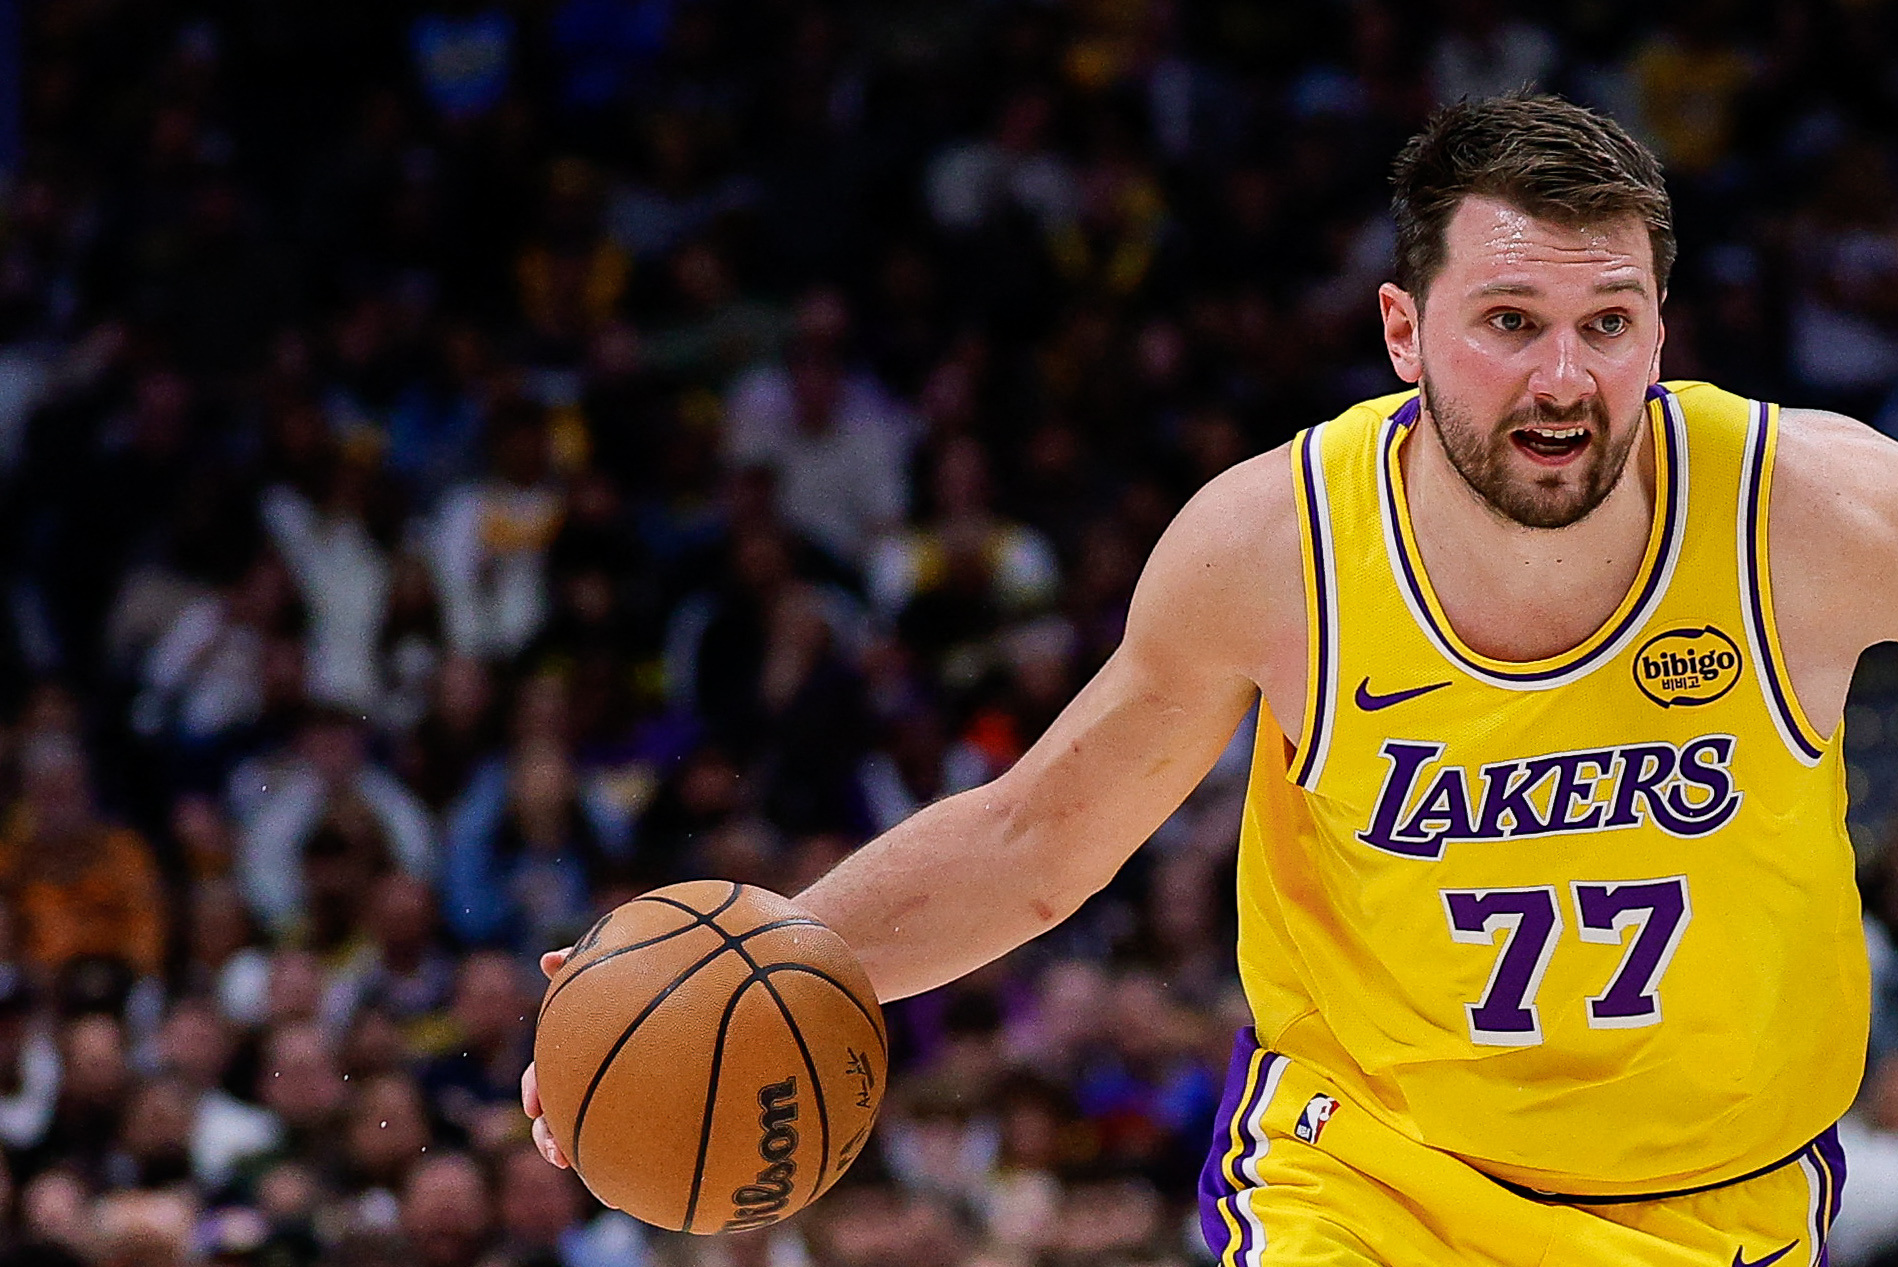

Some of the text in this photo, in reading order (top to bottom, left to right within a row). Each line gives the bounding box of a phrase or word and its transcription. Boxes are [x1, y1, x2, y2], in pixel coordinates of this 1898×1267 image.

[1641, 647, 1736, 681] bibigo
[1661, 675, 1702, 692] 비비고
[1354, 733, 1745, 862] LAKERS
[1438, 873, 1693, 1047] 77
